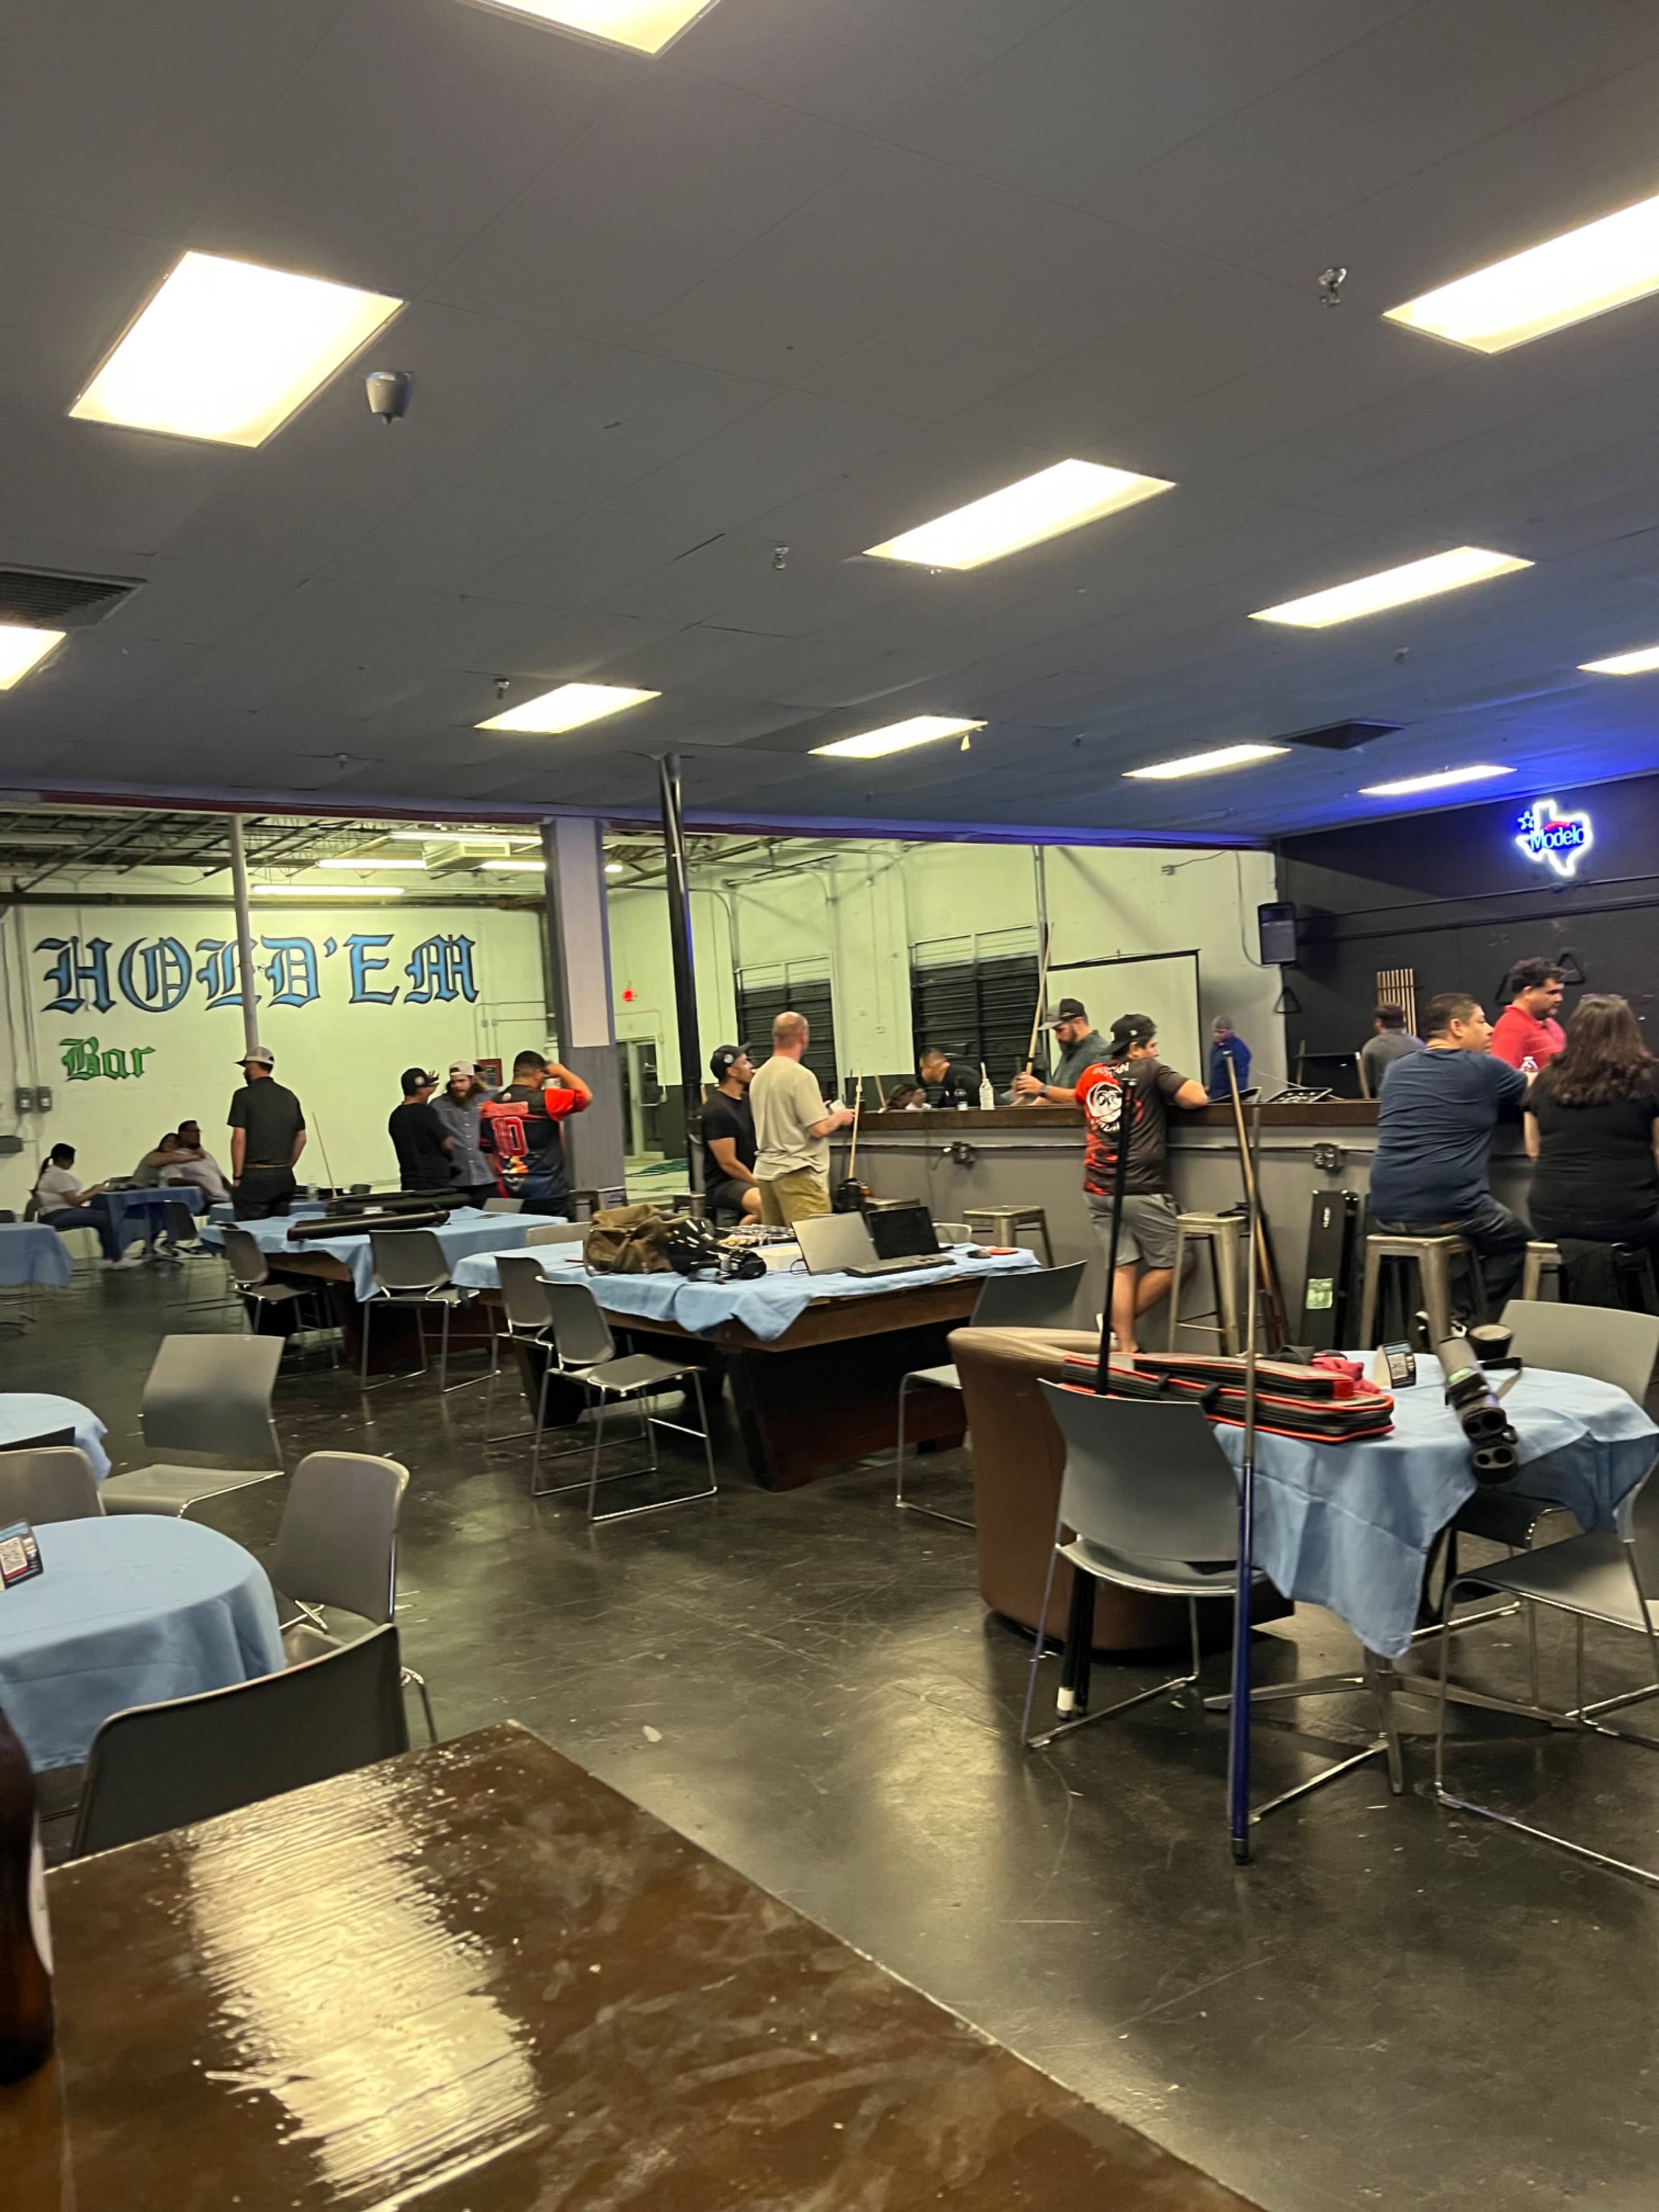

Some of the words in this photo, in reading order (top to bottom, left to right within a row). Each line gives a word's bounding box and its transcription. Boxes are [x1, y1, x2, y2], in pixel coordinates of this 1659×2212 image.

[1529, 824, 1584, 850] Modelo
[34, 934, 480, 1014] HOLD'EM
[59, 1036, 156, 1082] Bar
